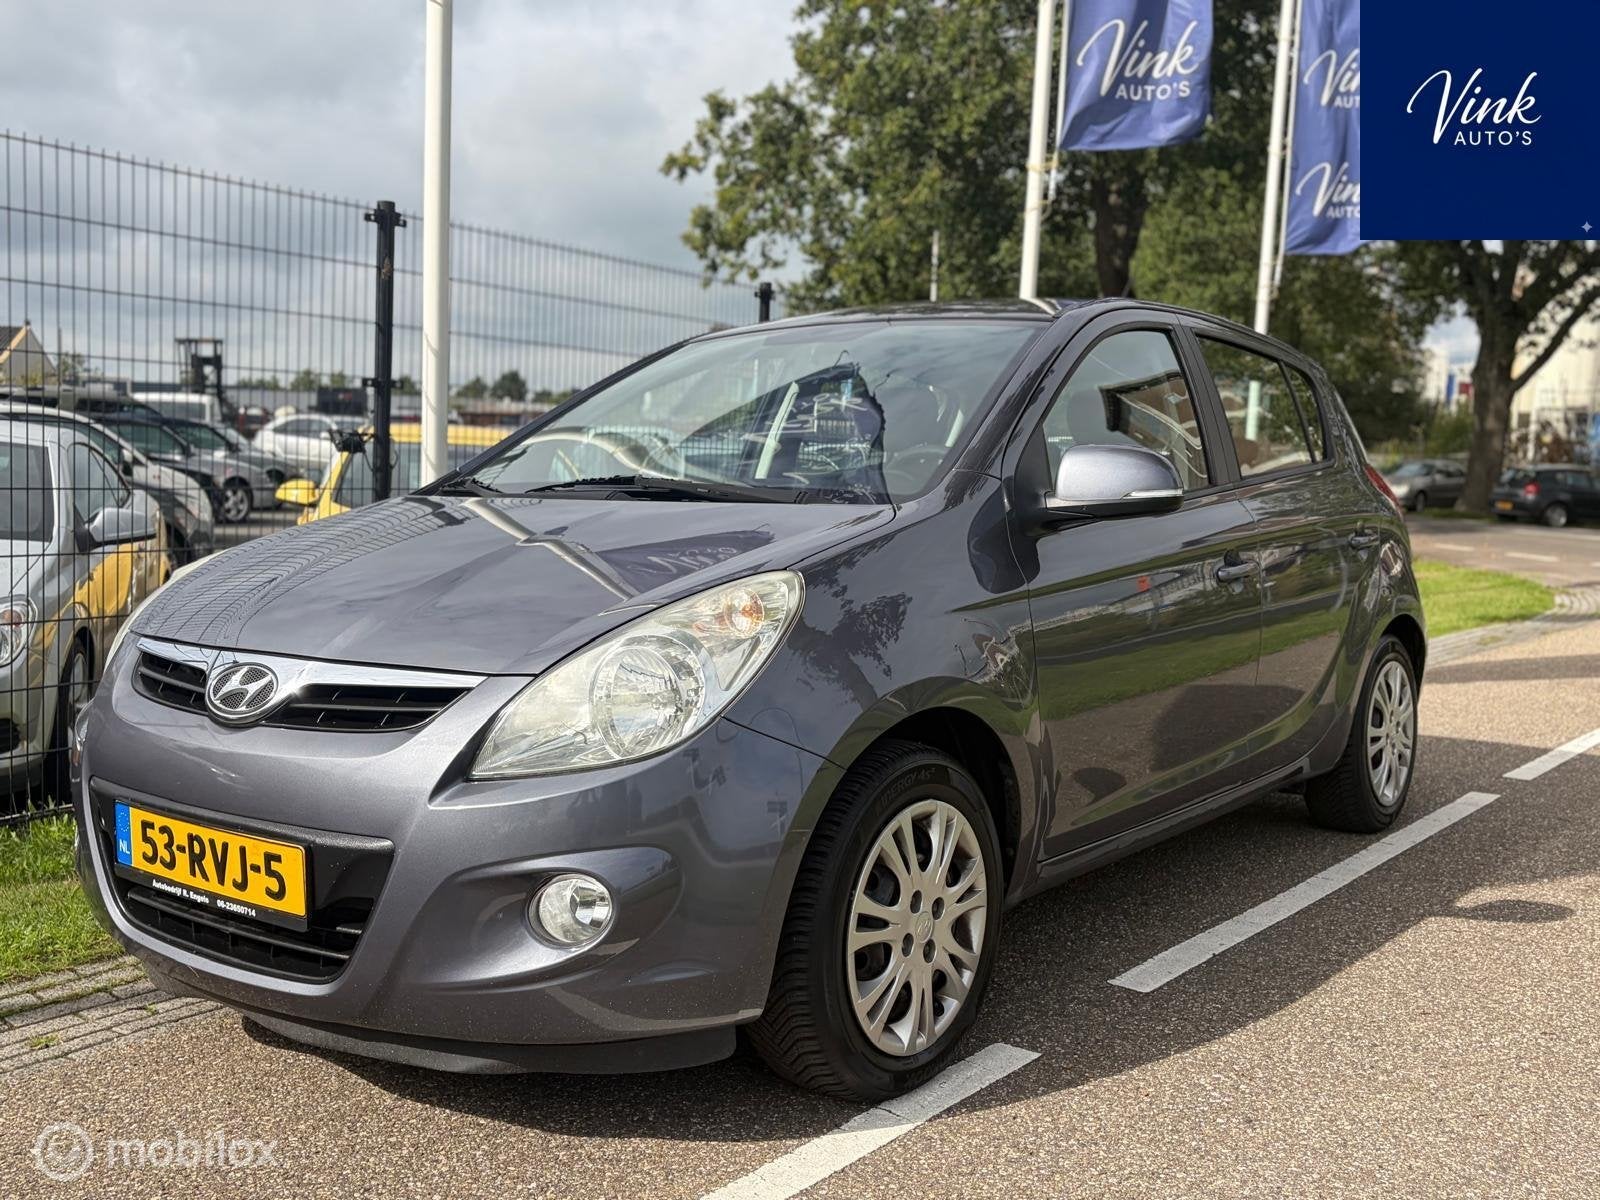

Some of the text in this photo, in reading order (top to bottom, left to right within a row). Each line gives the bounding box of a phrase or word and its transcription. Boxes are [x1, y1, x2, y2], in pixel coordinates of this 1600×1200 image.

[1077, 19, 1199, 97] Vink
[1115, 81, 1190, 101] AUTO'S
[119, 839, 130, 855] NL
[141, 819, 287, 901] 53-RVJ-5
[190, 891, 210, 904] Engels
